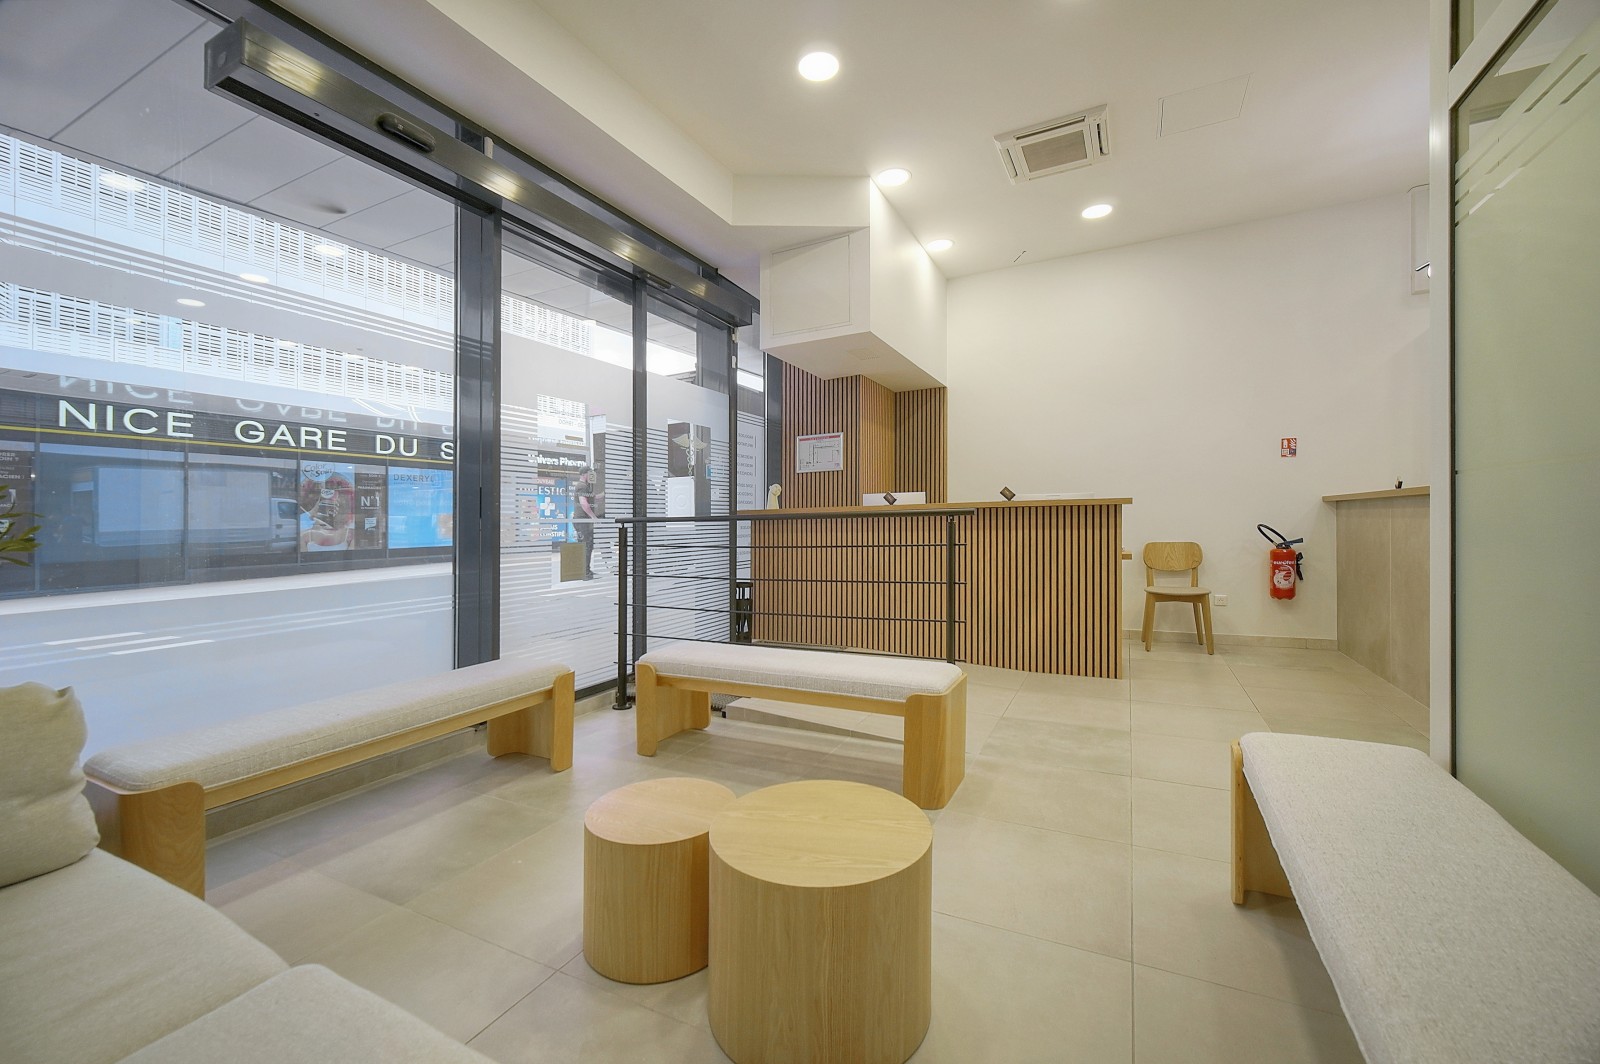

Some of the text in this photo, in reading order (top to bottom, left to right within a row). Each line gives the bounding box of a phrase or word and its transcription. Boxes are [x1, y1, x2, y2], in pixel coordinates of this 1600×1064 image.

[59, 400, 194, 438] NICE
[235, 420, 347, 451] GARE
[376, 434, 418, 457] DU
